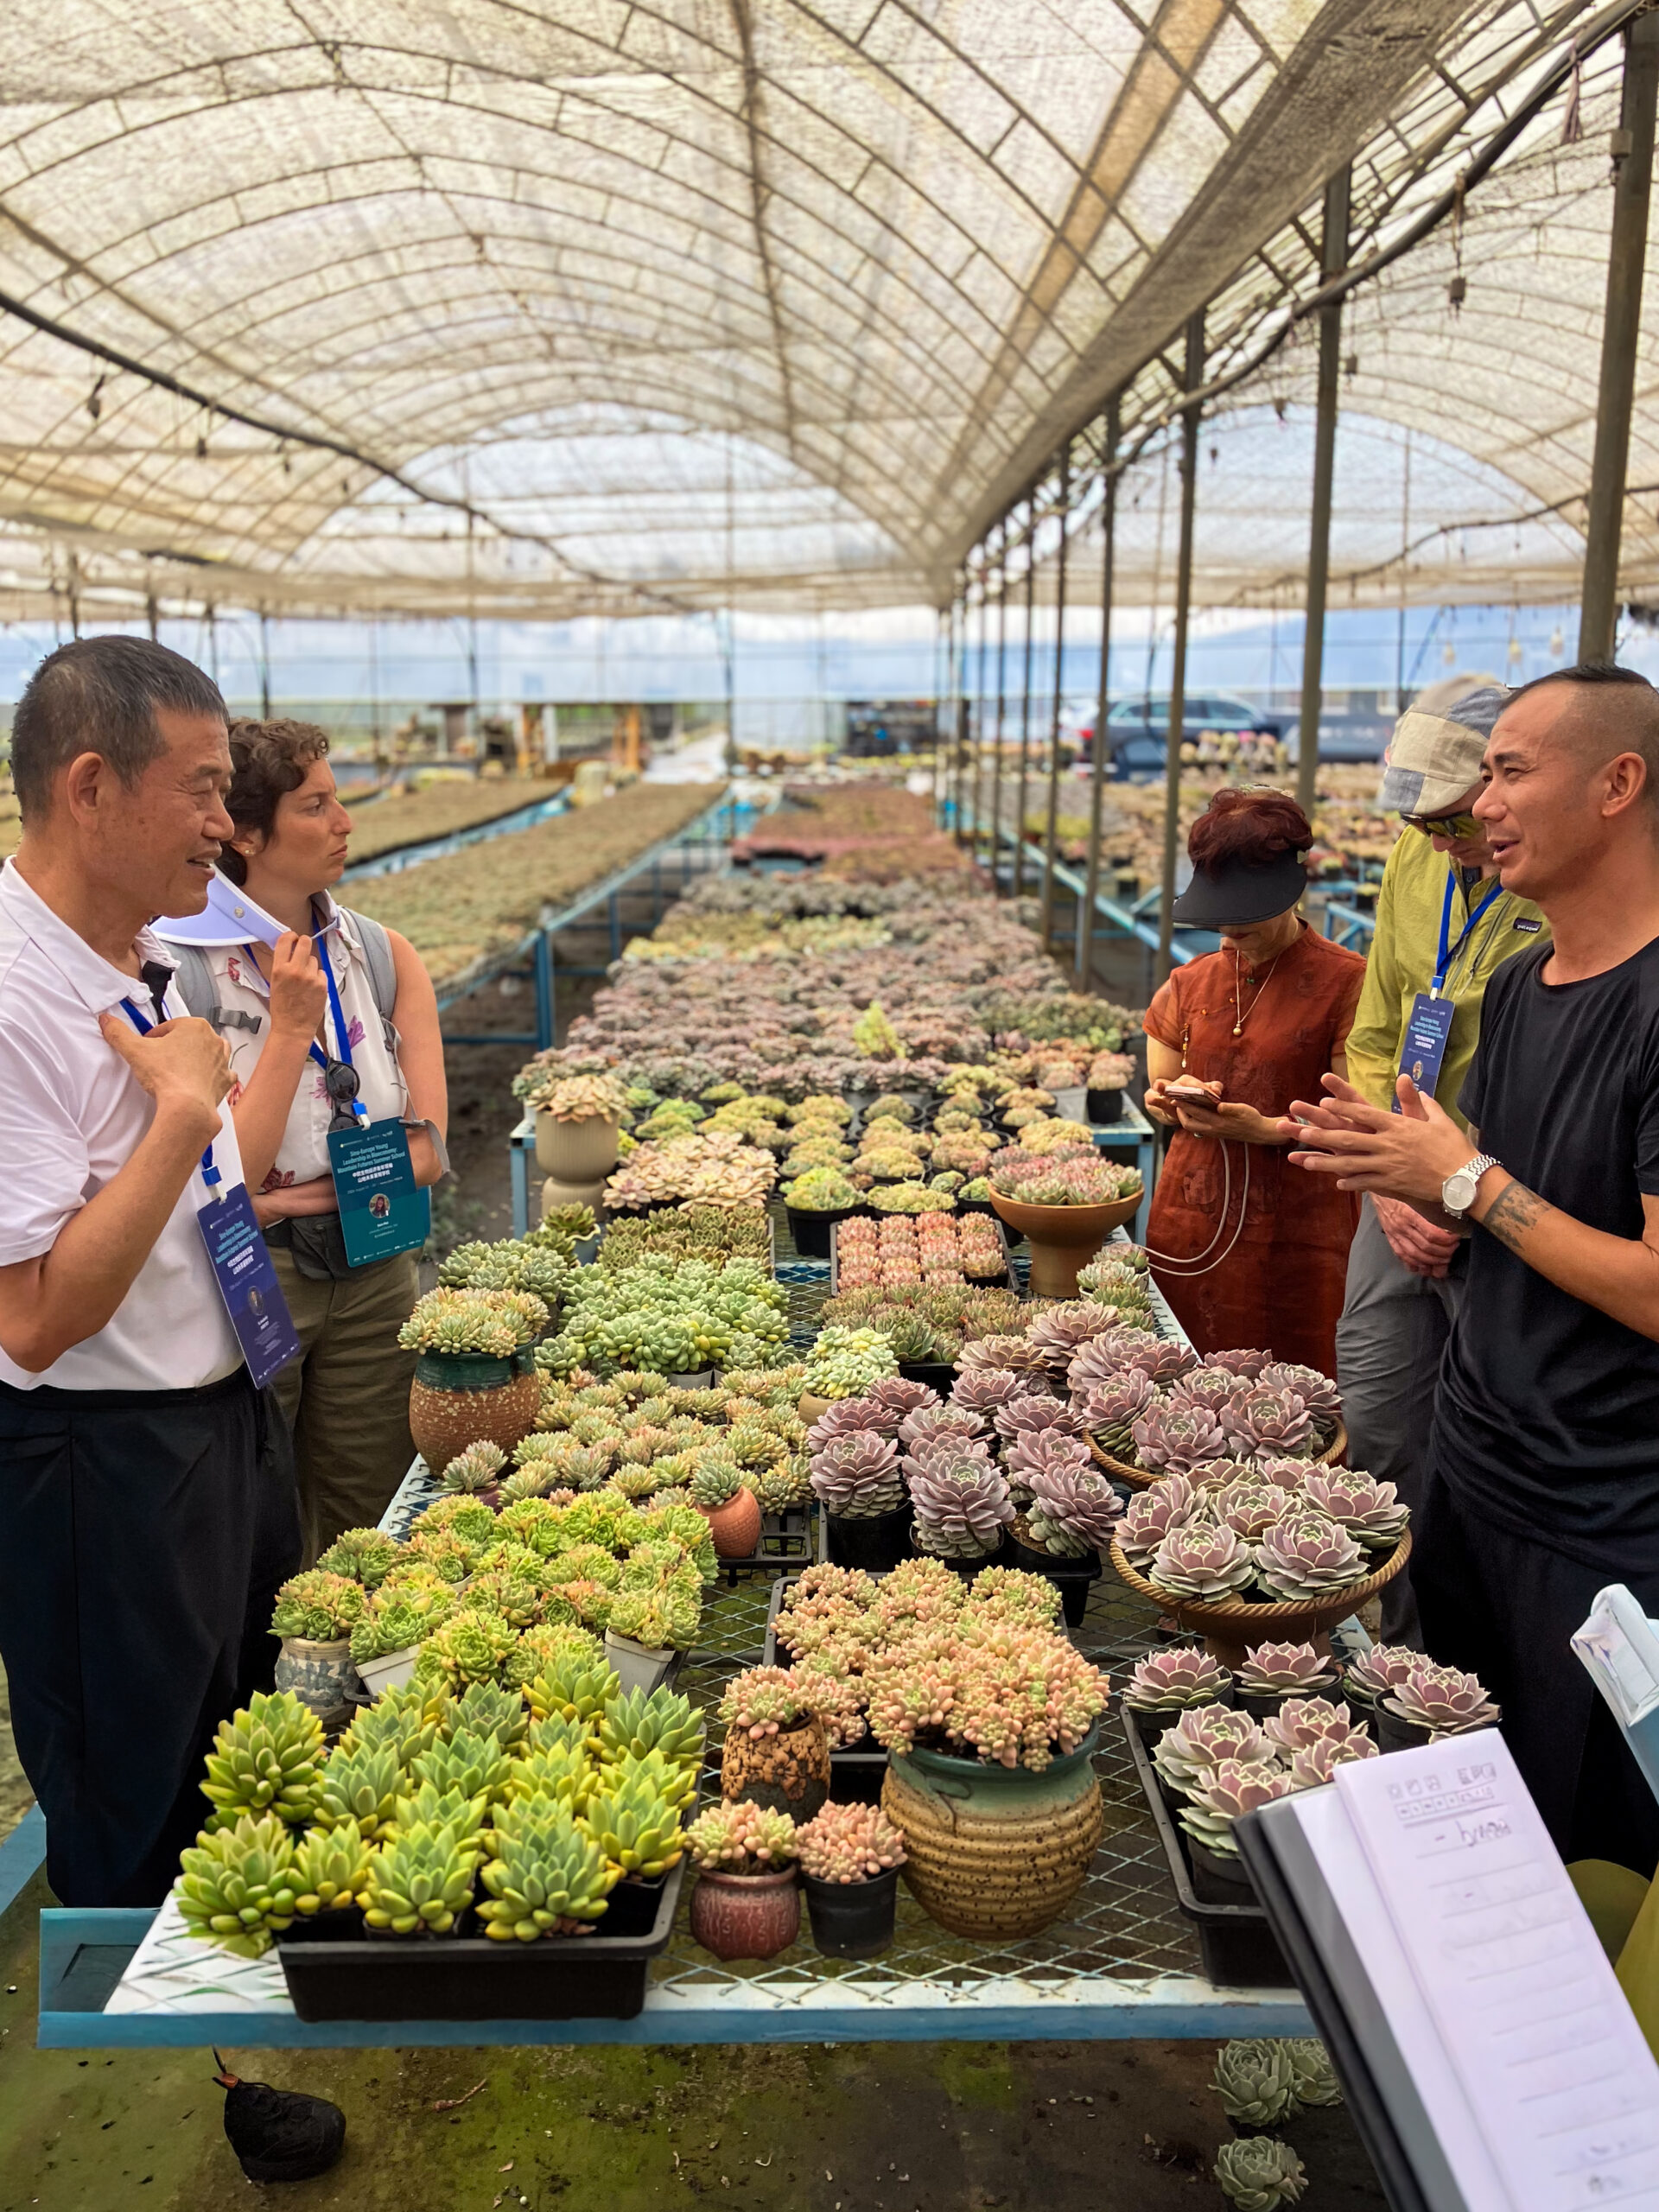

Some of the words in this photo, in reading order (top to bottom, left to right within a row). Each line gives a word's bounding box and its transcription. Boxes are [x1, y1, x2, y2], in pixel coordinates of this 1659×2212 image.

[337, 1165, 358, 1173] Mountain
[373, 1156, 391, 1165] Summer
[391, 1151, 405, 1160] School
[342, 1155, 366, 1166] Leadership
